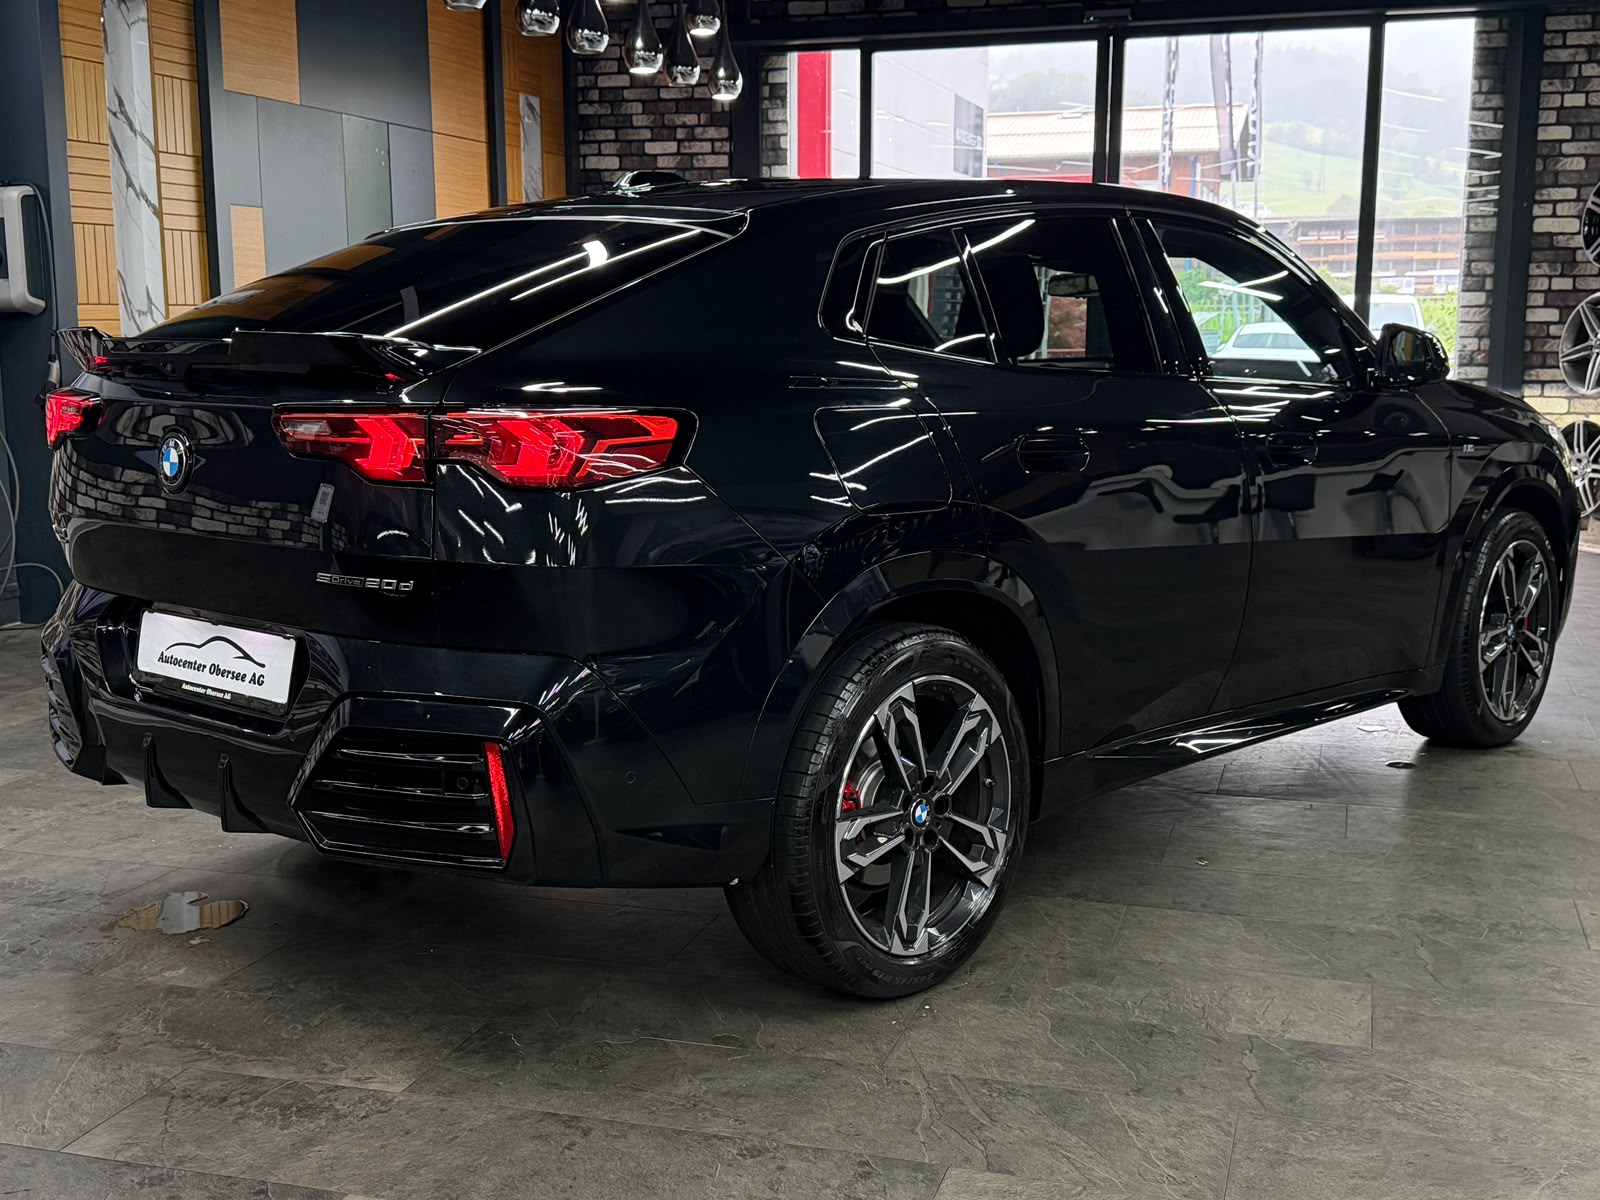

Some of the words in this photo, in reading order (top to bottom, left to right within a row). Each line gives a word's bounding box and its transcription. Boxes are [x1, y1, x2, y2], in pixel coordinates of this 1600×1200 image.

[158, 651, 207, 673] Autocenter
[209, 663, 247, 682] Obersee
[249, 672, 265, 686] AG
[181, 683, 206, 695] Autocenter
[206, 687, 224, 698] Obersee
[224, 692, 231, 700] AG
